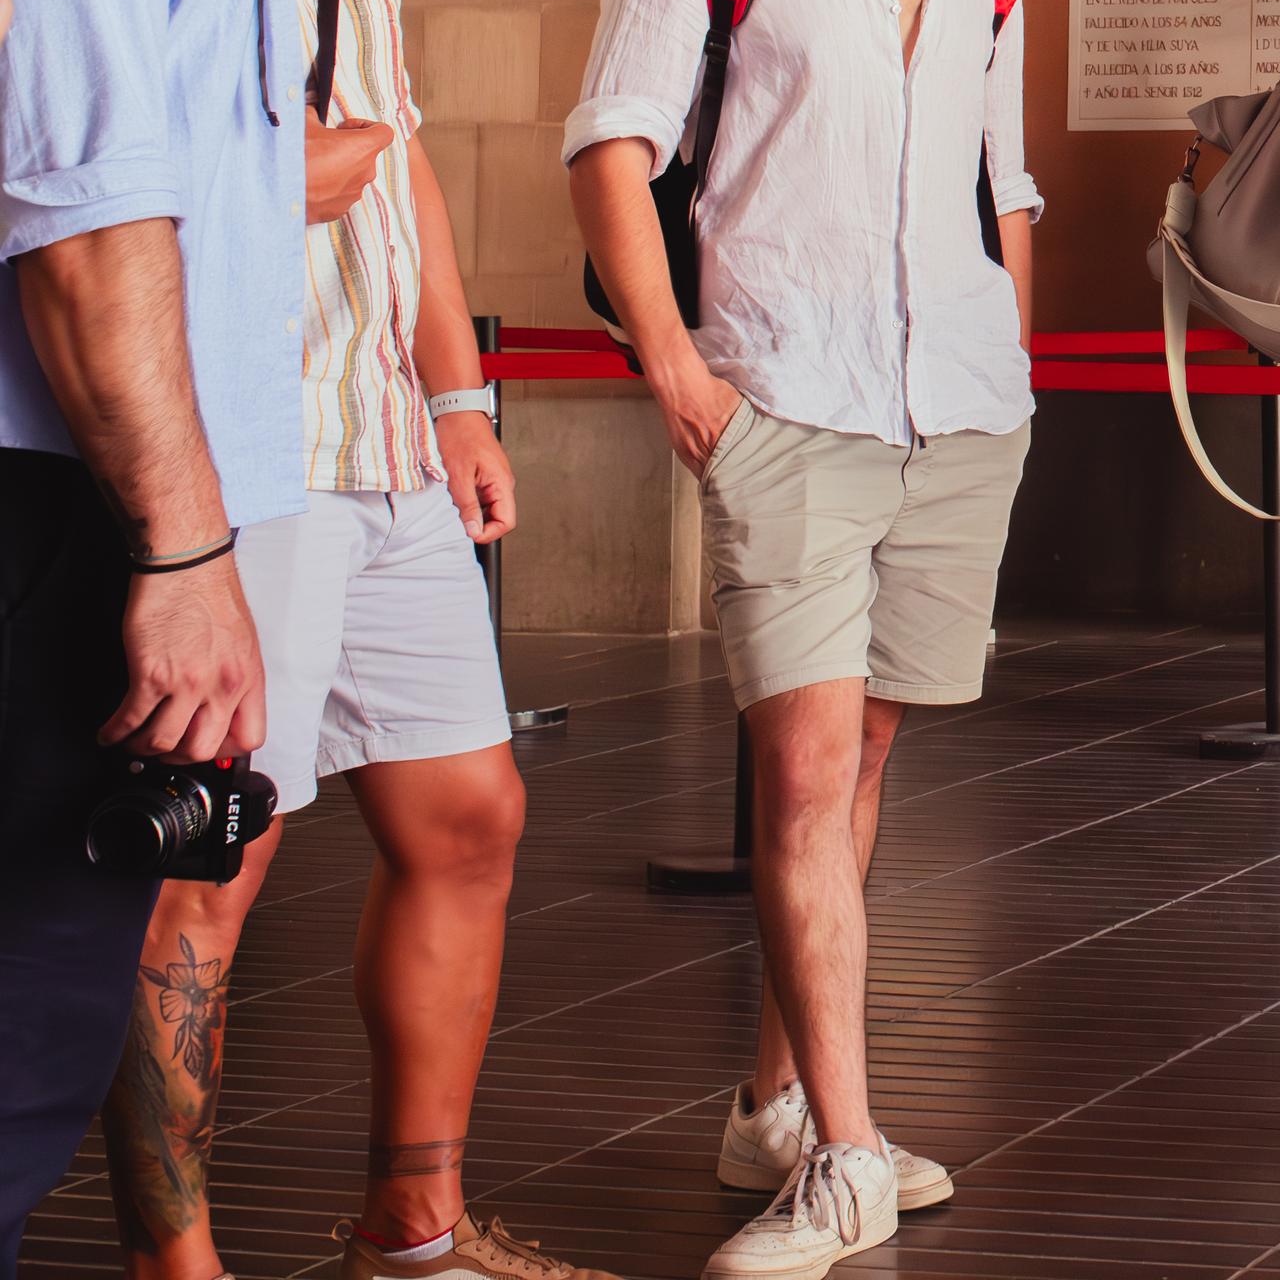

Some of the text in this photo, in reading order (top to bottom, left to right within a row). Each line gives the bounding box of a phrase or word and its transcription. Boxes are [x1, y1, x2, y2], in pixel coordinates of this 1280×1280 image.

[1085, 17, 1139, 29] FALLECIDO
[1141, 17, 1149, 29] A
[1152, 17, 1172, 29] LOS
[1085, 40, 1093, 52] Y
[1097, 40, 1110, 52] DE
[1114, 40, 1137, 52] UNA
[1170, 39, 1199, 51] SUYA
[1256, 39, 1259, 50] I
[1085, 61, 1219, 76] FALLECIDA A LOS 13 AÑOS
[1121, 86, 1139, 98] DEL
[1183, 86, 1203, 98] 1512
[225, 794, 240, 844] LEICA
